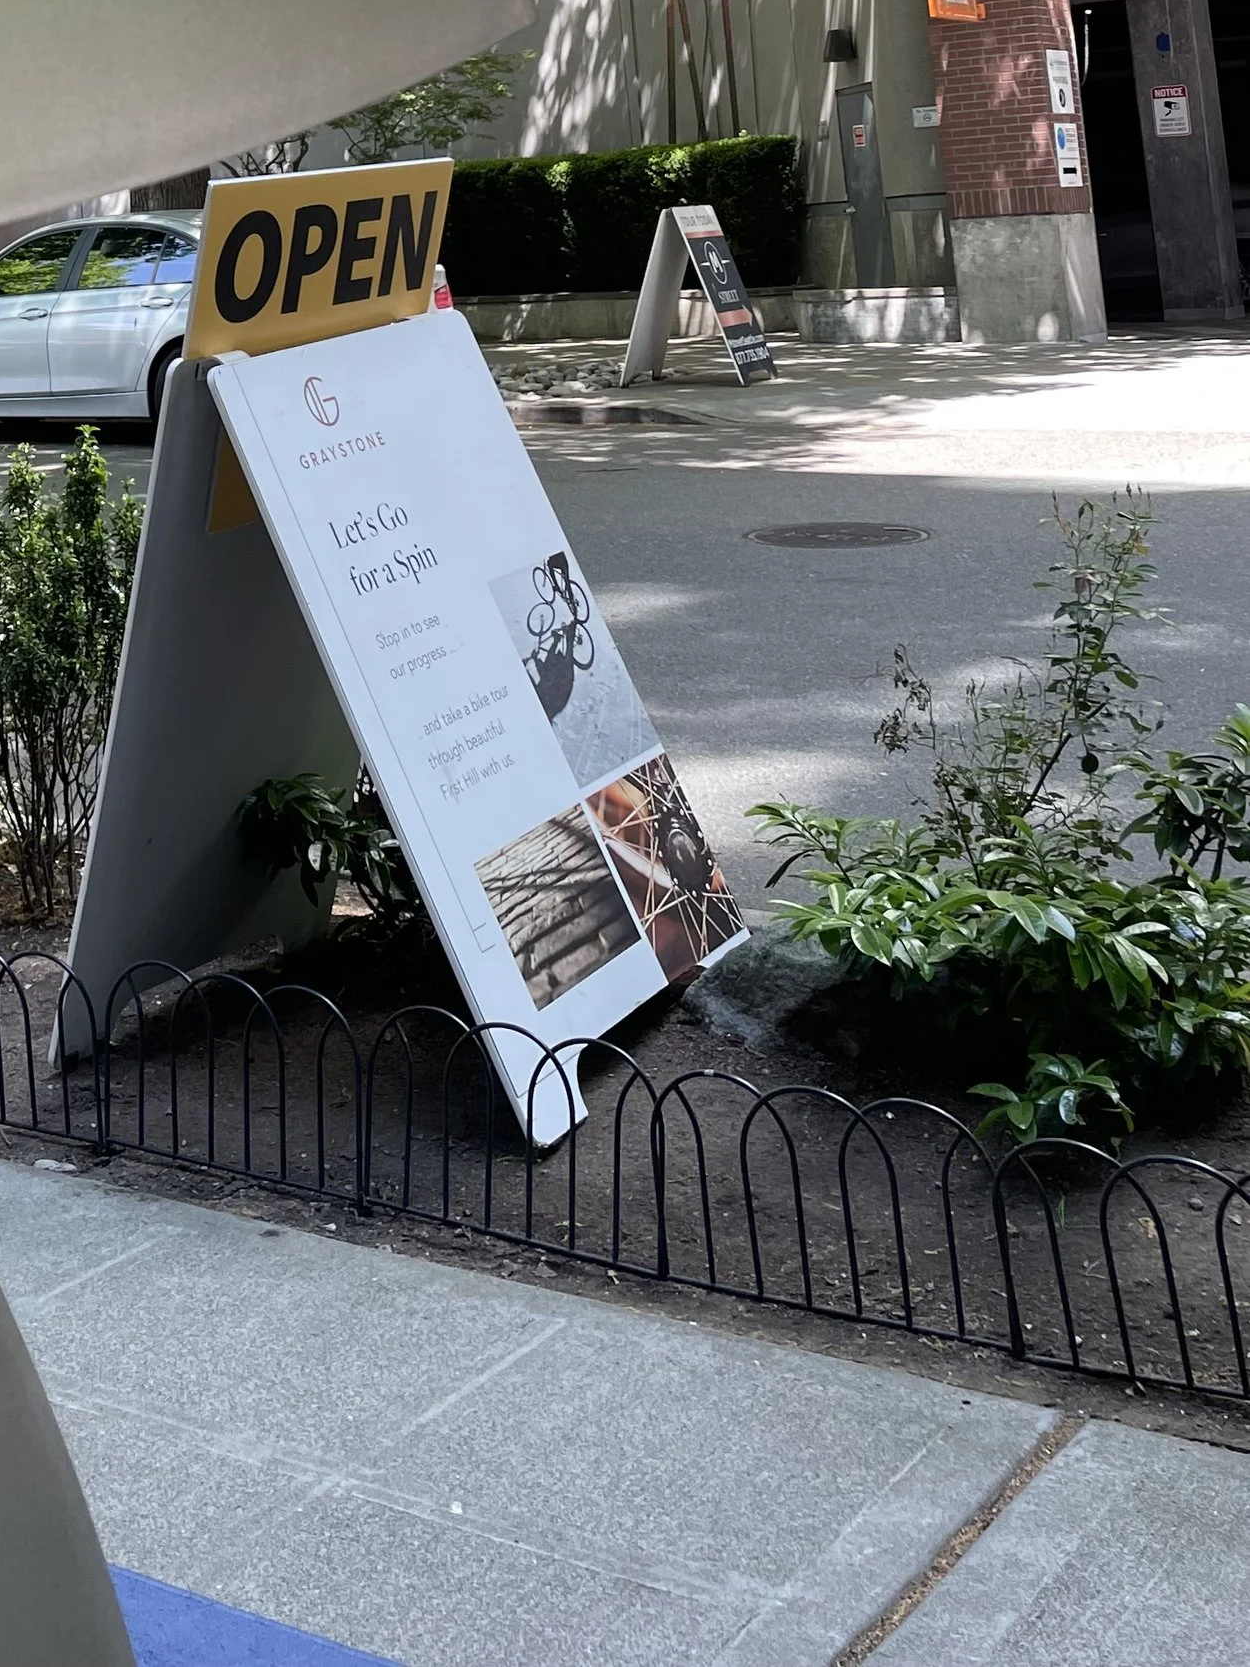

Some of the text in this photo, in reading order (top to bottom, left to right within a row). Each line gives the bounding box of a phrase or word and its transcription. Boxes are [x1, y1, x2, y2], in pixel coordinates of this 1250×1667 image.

[1154, 87, 1184, 98] NOTICE
[215, 191, 438, 323] OPEN
[708, 251, 724, 274] M
[717, 289, 740, 304] STREET
[303, 376, 340, 426] G
[299, 431, 386, 470] GRAYSTONE
[329, 502, 408, 550] Let's Go
[349, 543, 438, 596] for a Spin
[375, 614, 440, 650] Stop in to see
[390, 663, 406, 680] our
[423, 685, 509, 736] and take a bike tour
[427, 718, 506, 770] through beautiful
[439, 779, 465, 800] First
[462, 766, 481, 789] Hill
[480, 756, 502, 779] with
